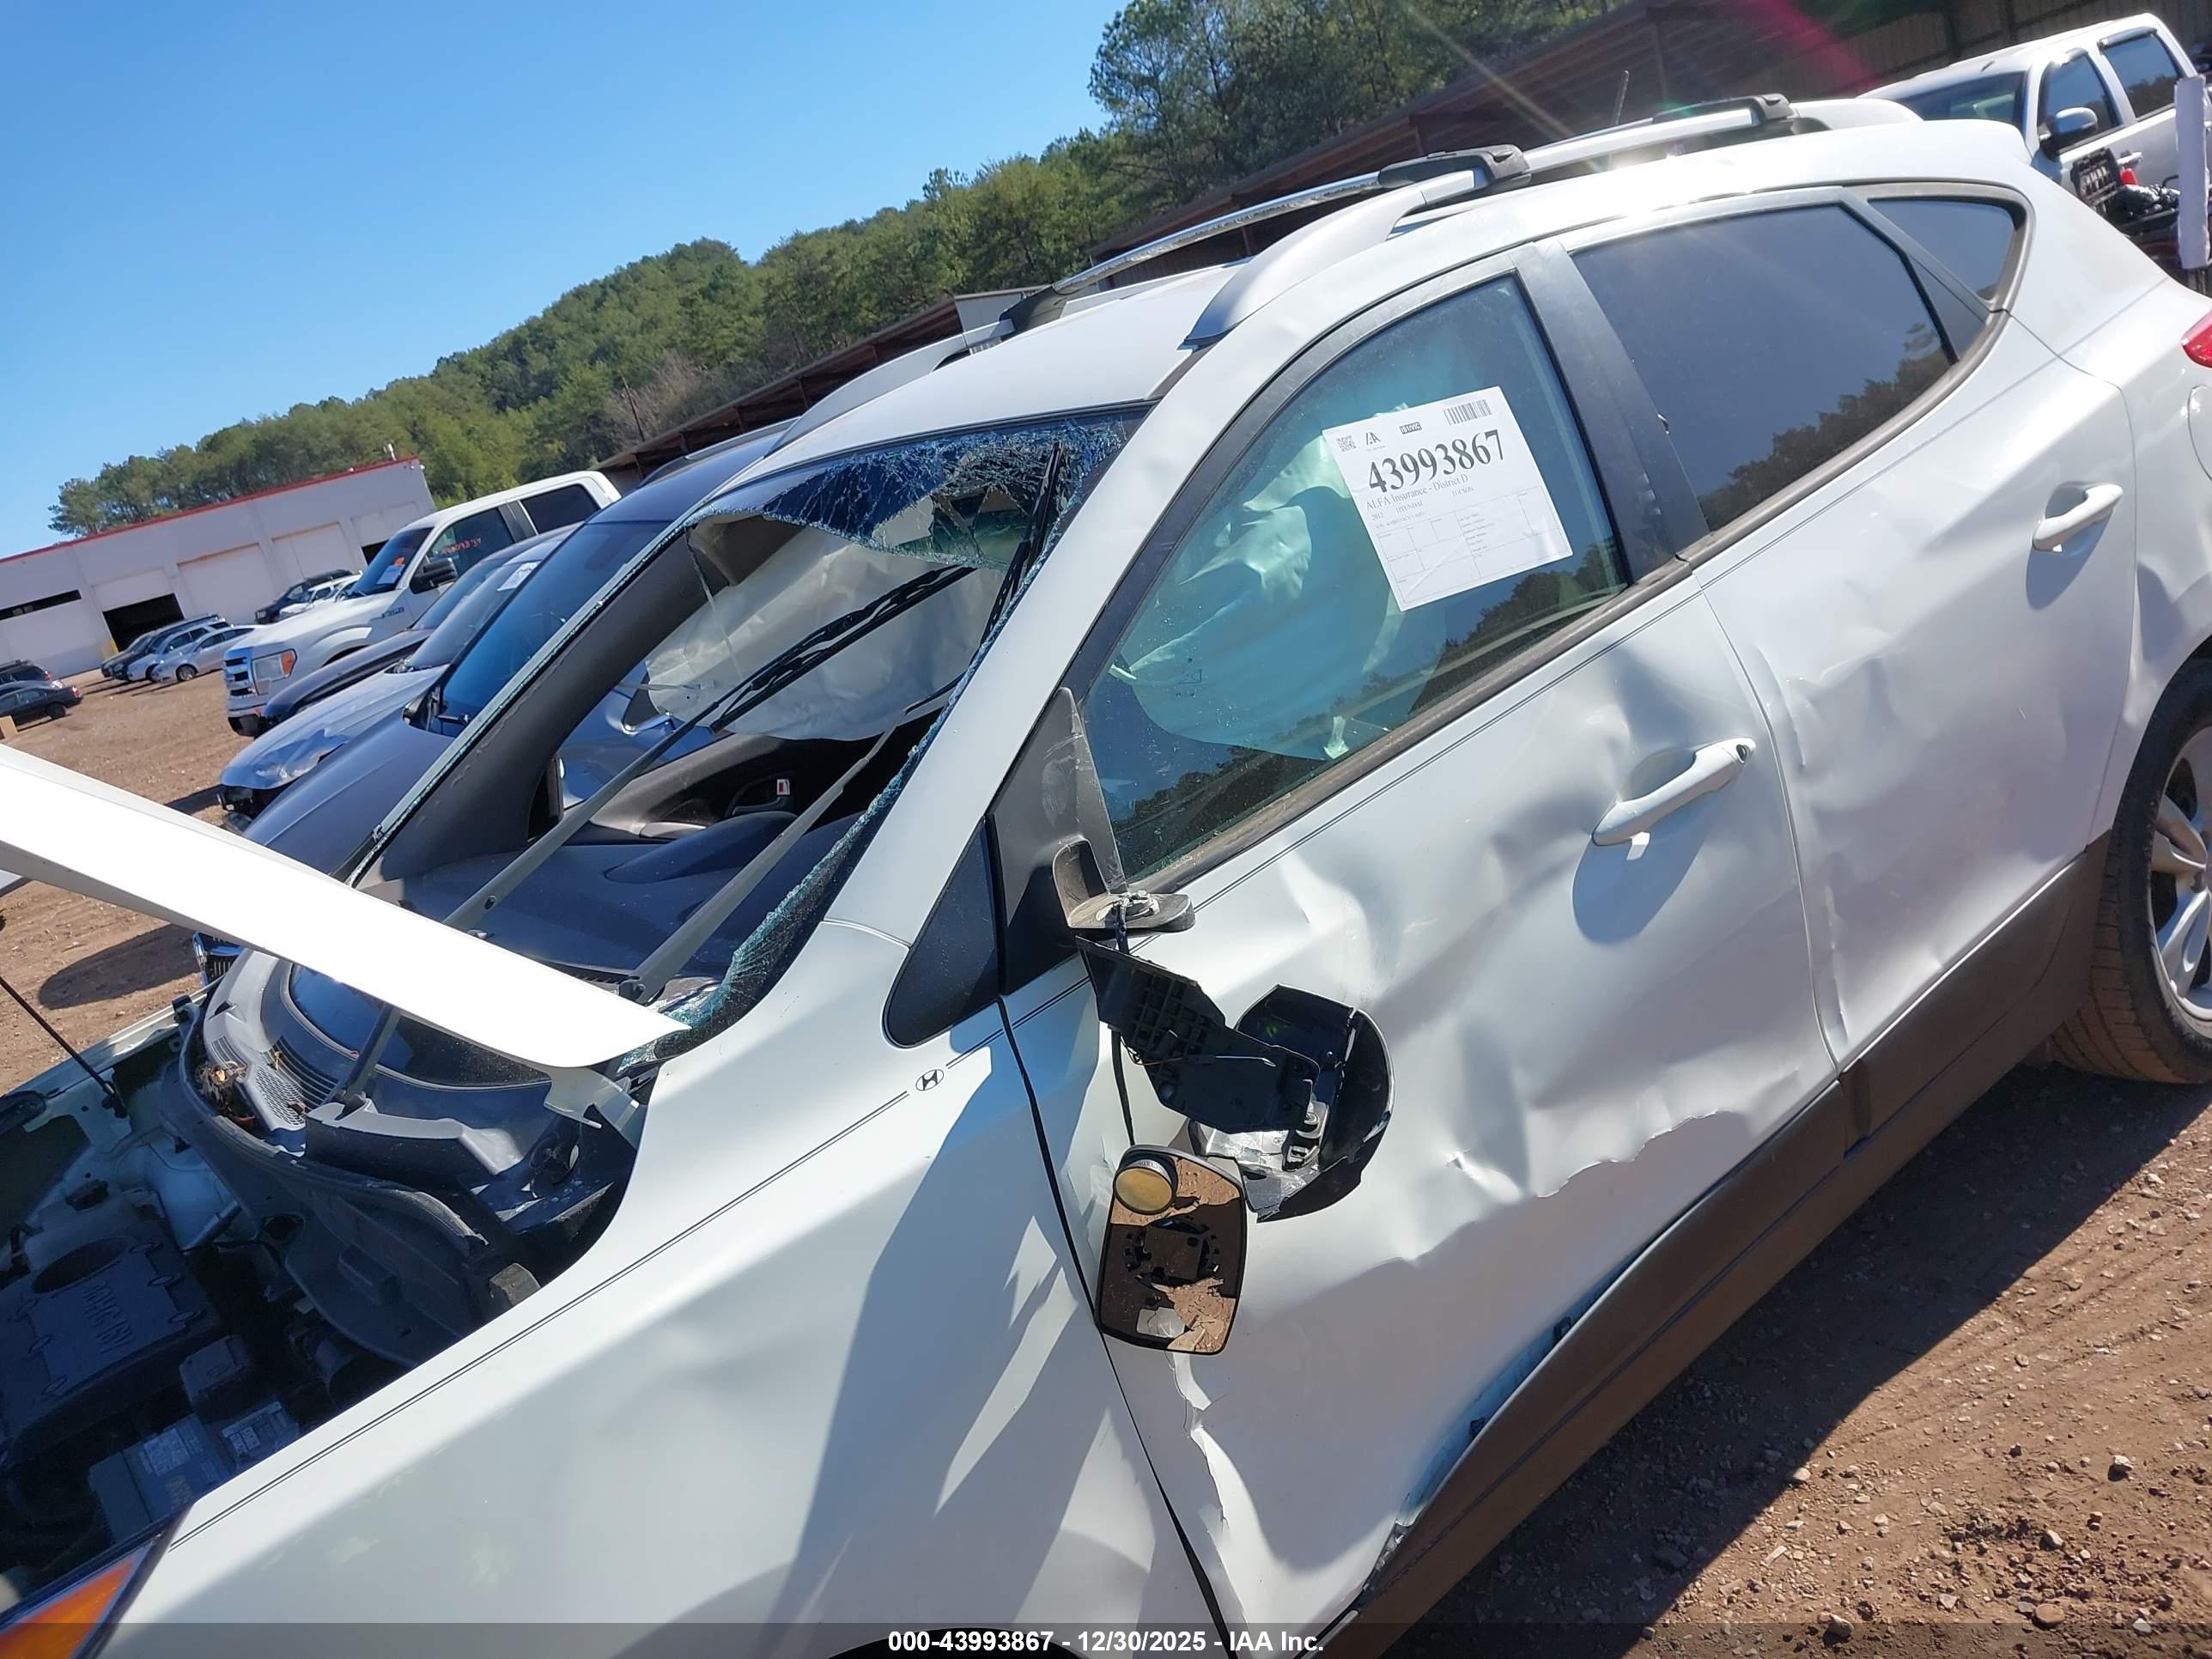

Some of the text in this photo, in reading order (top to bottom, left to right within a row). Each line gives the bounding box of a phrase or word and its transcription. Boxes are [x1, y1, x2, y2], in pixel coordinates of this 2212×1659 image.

[1369, 428, 1504, 493] 43993867
[1366, 497, 1390, 512] ALFA
[1393, 487, 1427, 503] Insurance
[1432, 477, 1460, 492] District
[1461, 474, 1468, 483] D
